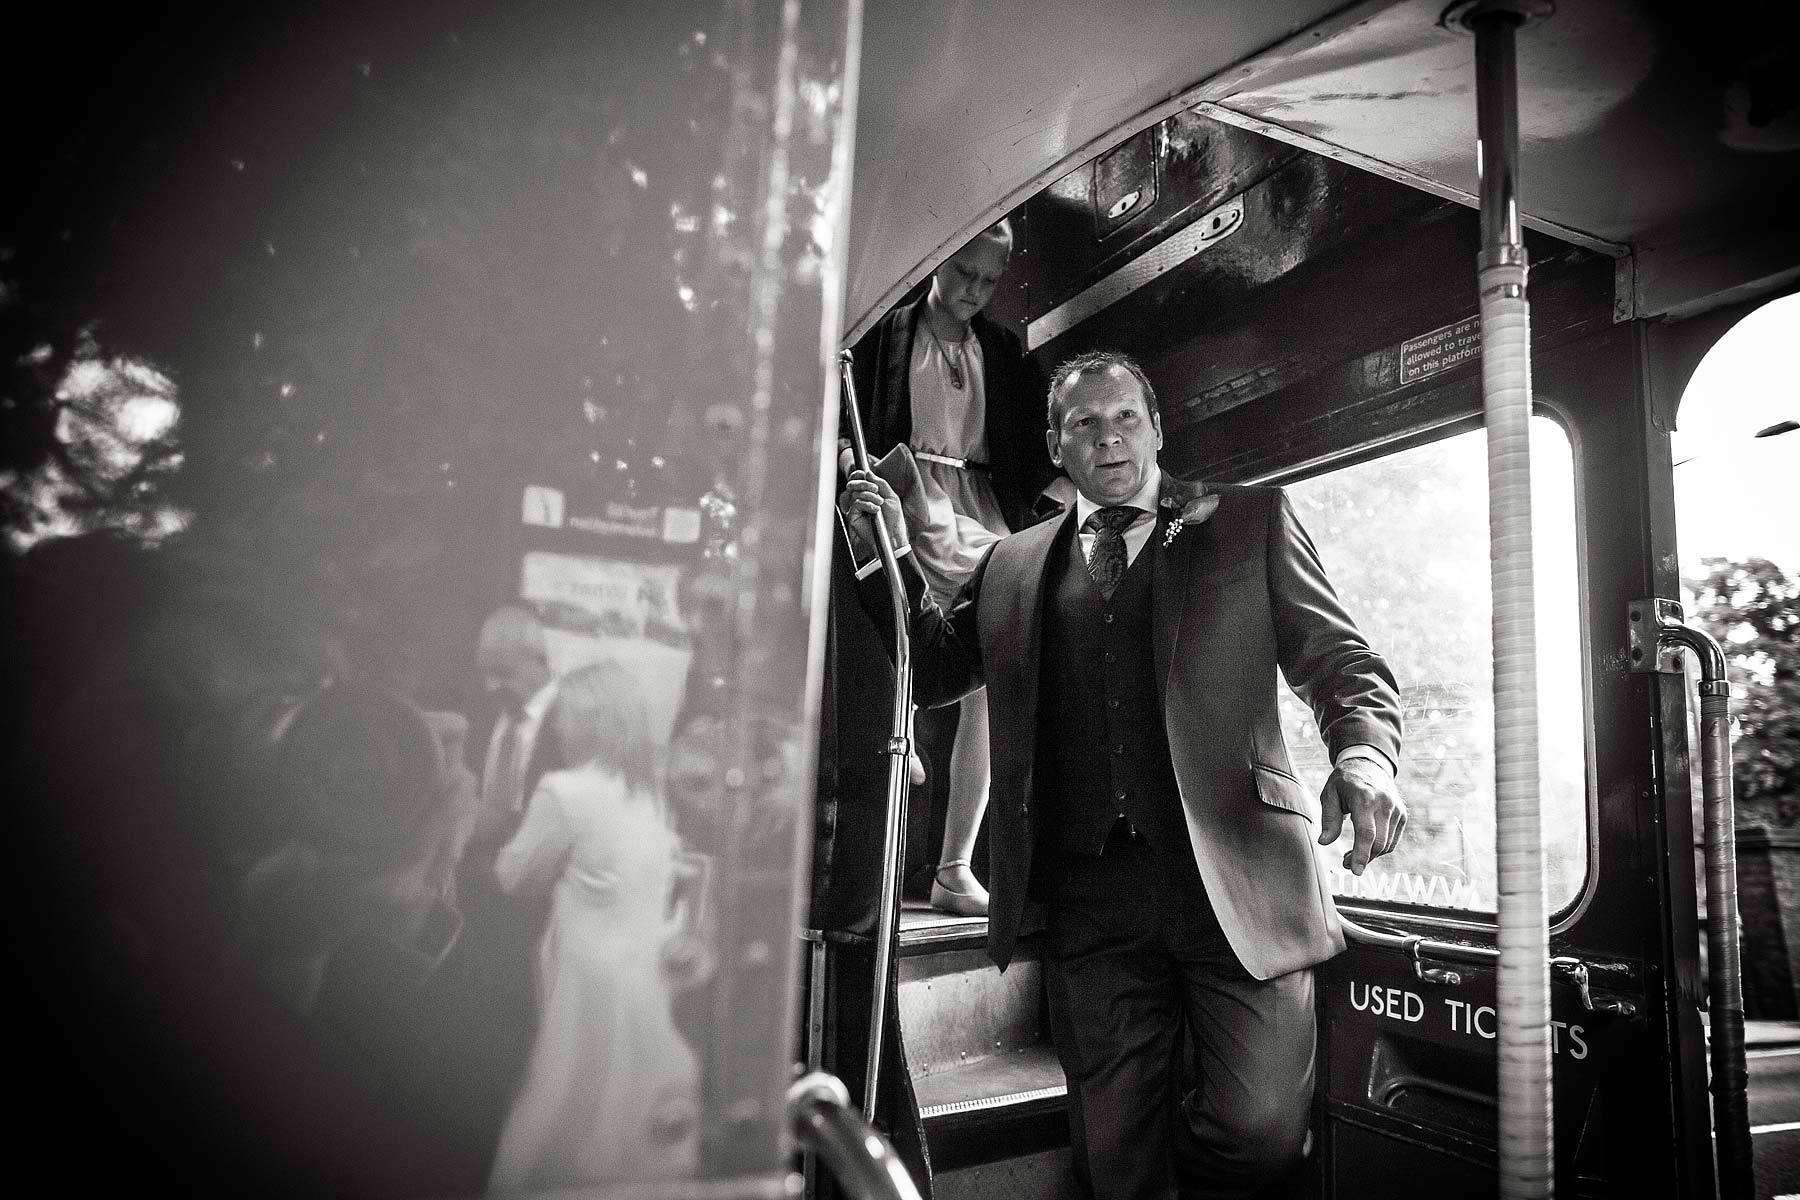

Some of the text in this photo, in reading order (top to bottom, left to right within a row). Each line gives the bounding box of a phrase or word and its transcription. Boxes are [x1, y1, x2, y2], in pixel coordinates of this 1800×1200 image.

[1403, 330, 1452, 354] Passengers
[1455, 323, 1471, 335] are
[1406, 344, 1442, 366] allowed
[1444, 342, 1456, 351] to
[1408, 345, 1483, 377] on this platform
[1350, 981, 1588, 1060] USED TICTS
